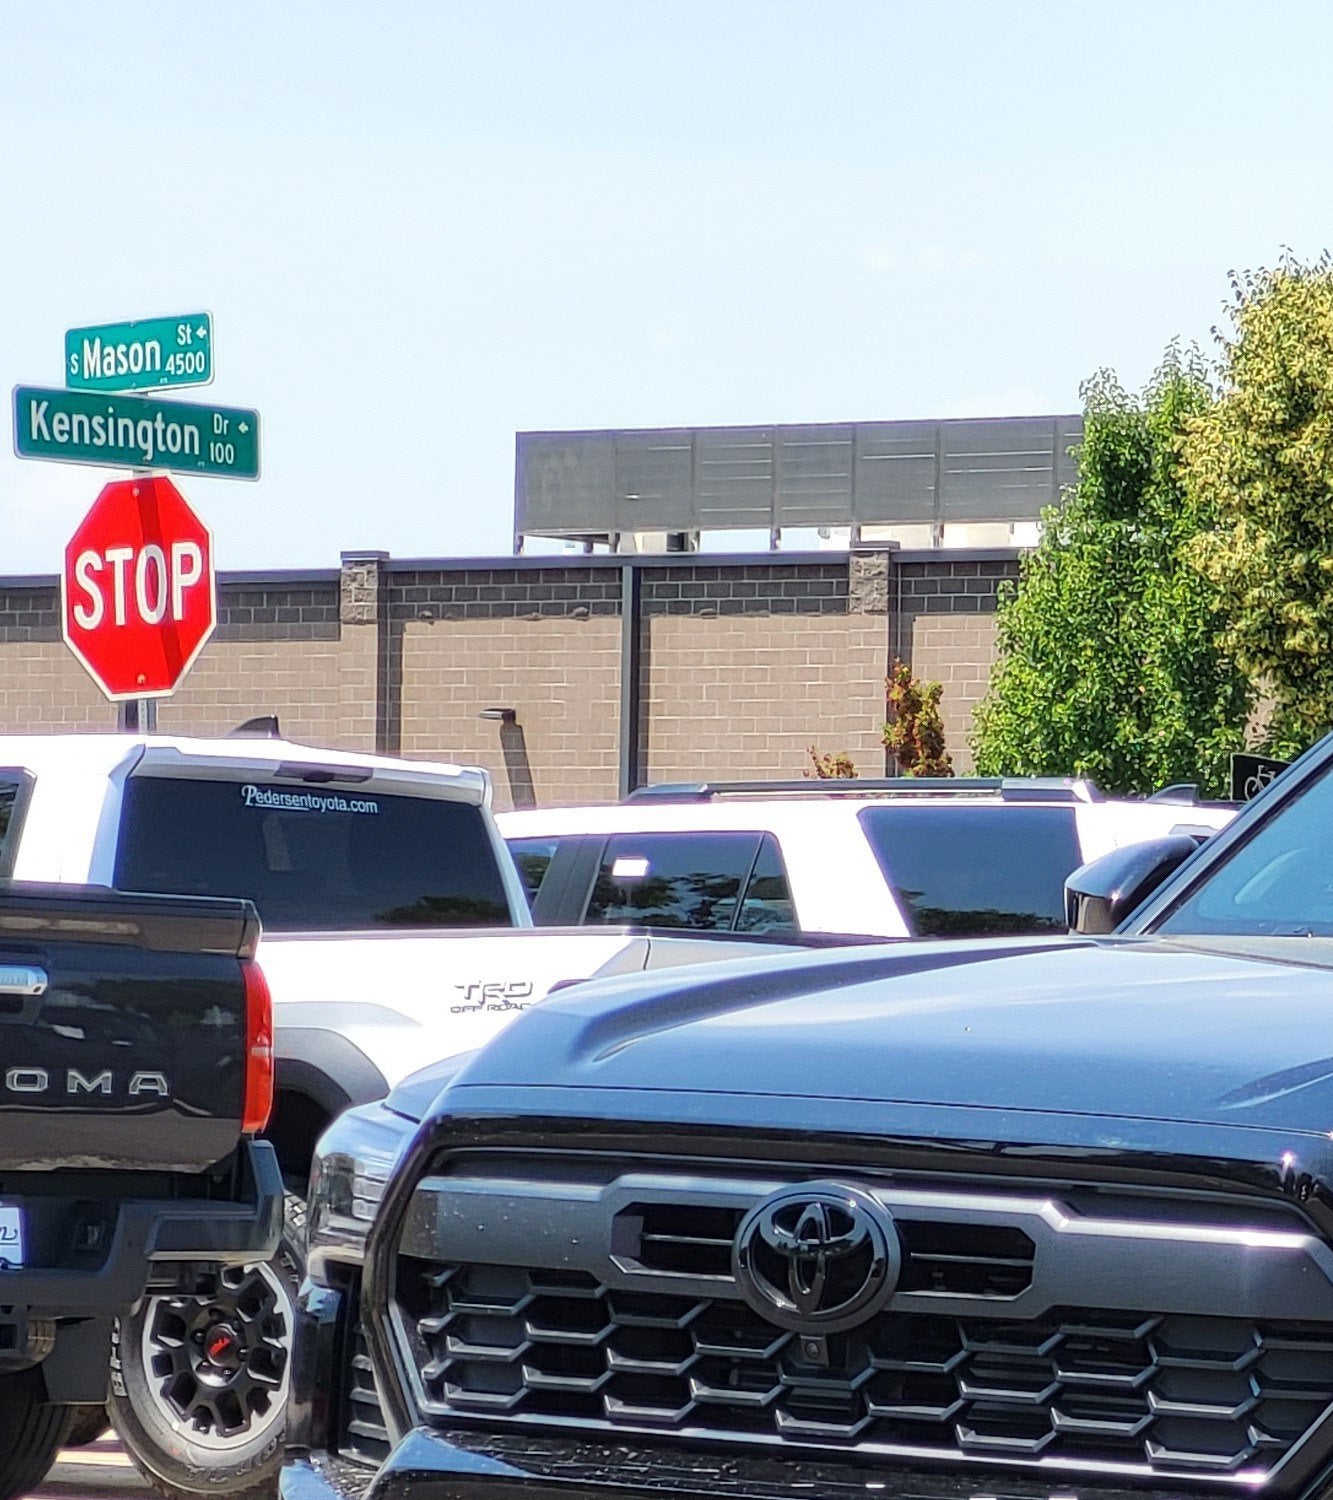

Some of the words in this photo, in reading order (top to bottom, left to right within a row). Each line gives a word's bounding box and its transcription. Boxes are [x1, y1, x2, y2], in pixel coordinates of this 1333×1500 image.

[83, 337, 161, 379] Mason
[177, 324, 192, 345] St
[165, 350, 205, 374] 4500
[30, 400, 199, 461] Kensington
[213, 413, 229, 435] Dr
[210, 442, 234, 464] 100
[73, 541, 202, 630] STOP
[241, 785, 378, 813] Pedersentoyota.com
[454, 980, 534, 1006] TRD
[6, 1067, 170, 1097] OMA
